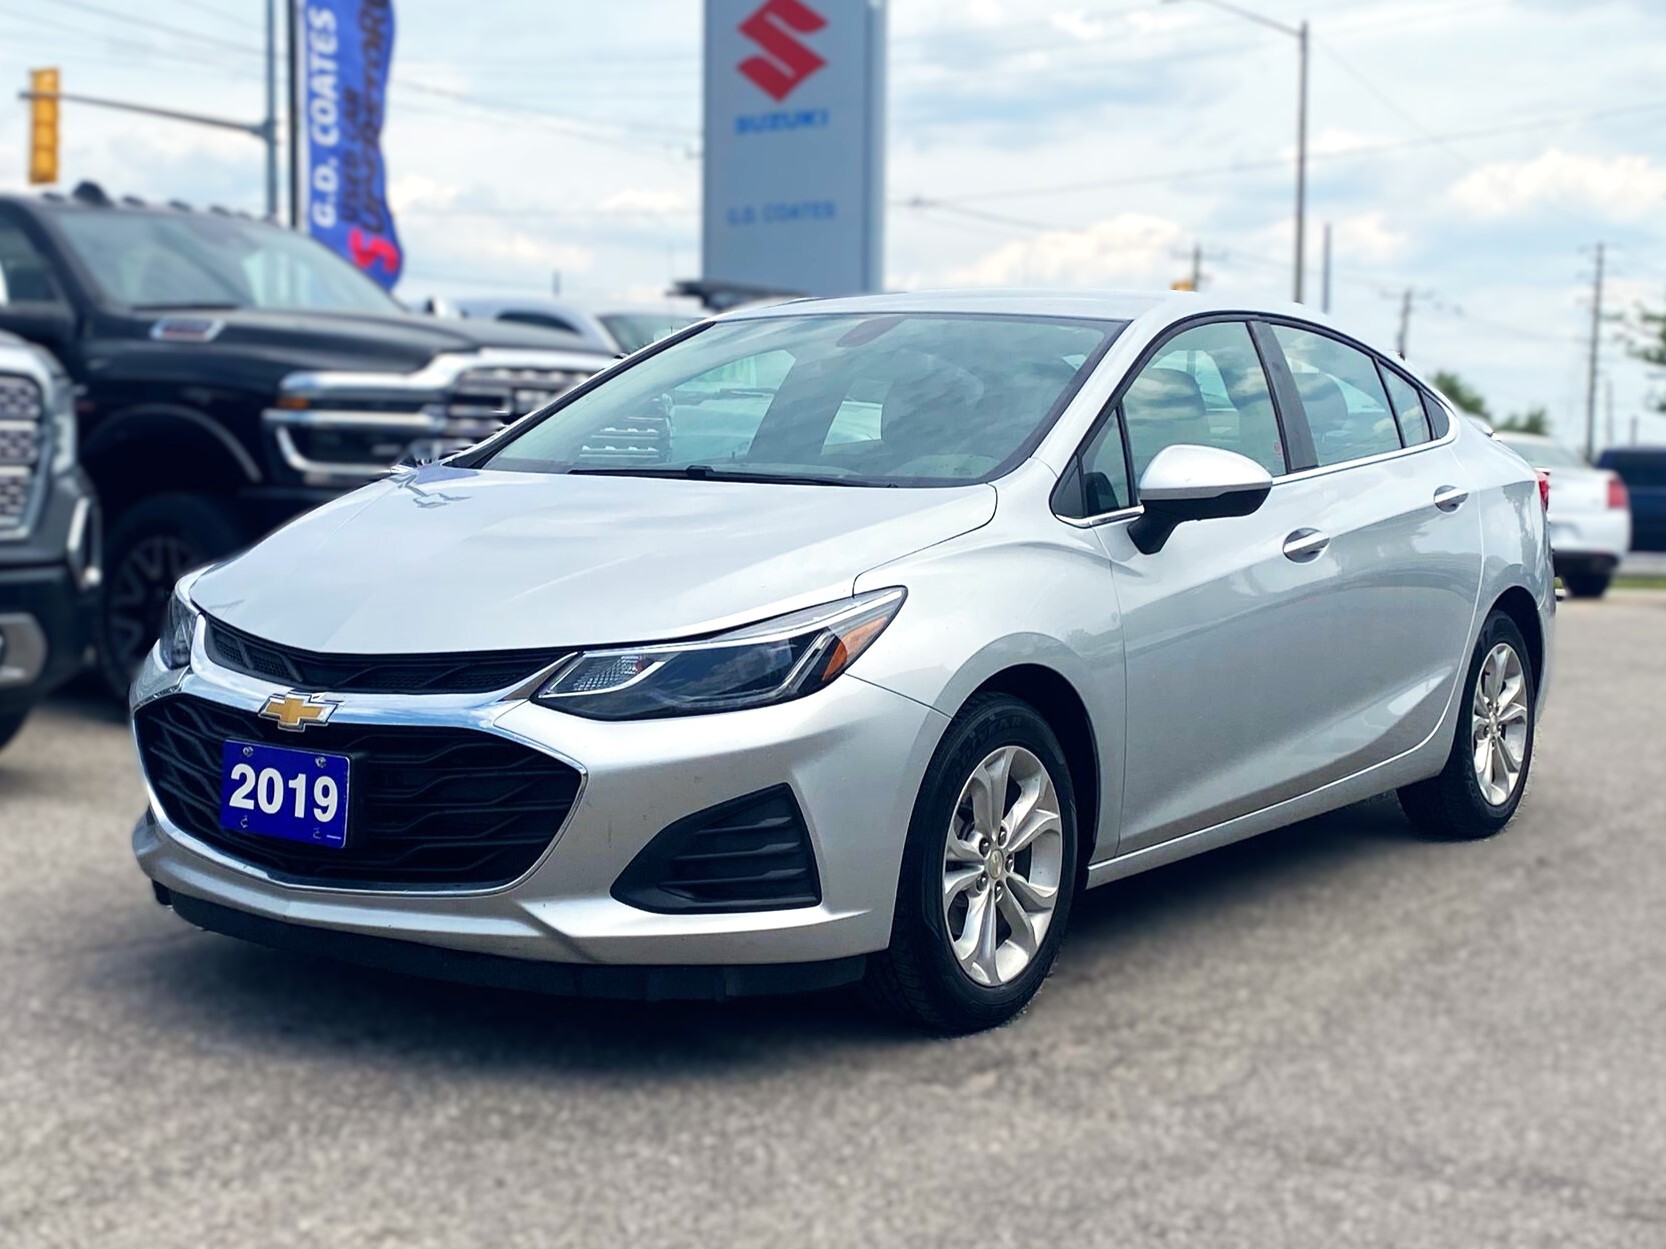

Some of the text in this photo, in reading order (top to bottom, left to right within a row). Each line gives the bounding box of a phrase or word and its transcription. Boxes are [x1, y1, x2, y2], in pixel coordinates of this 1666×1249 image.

[308, 6, 340, 147] COATES
[734, 108, 830, 134] SUZUKI
[762, 200, 836, 222] COATES
[229, 763, 338, 823] 2019
